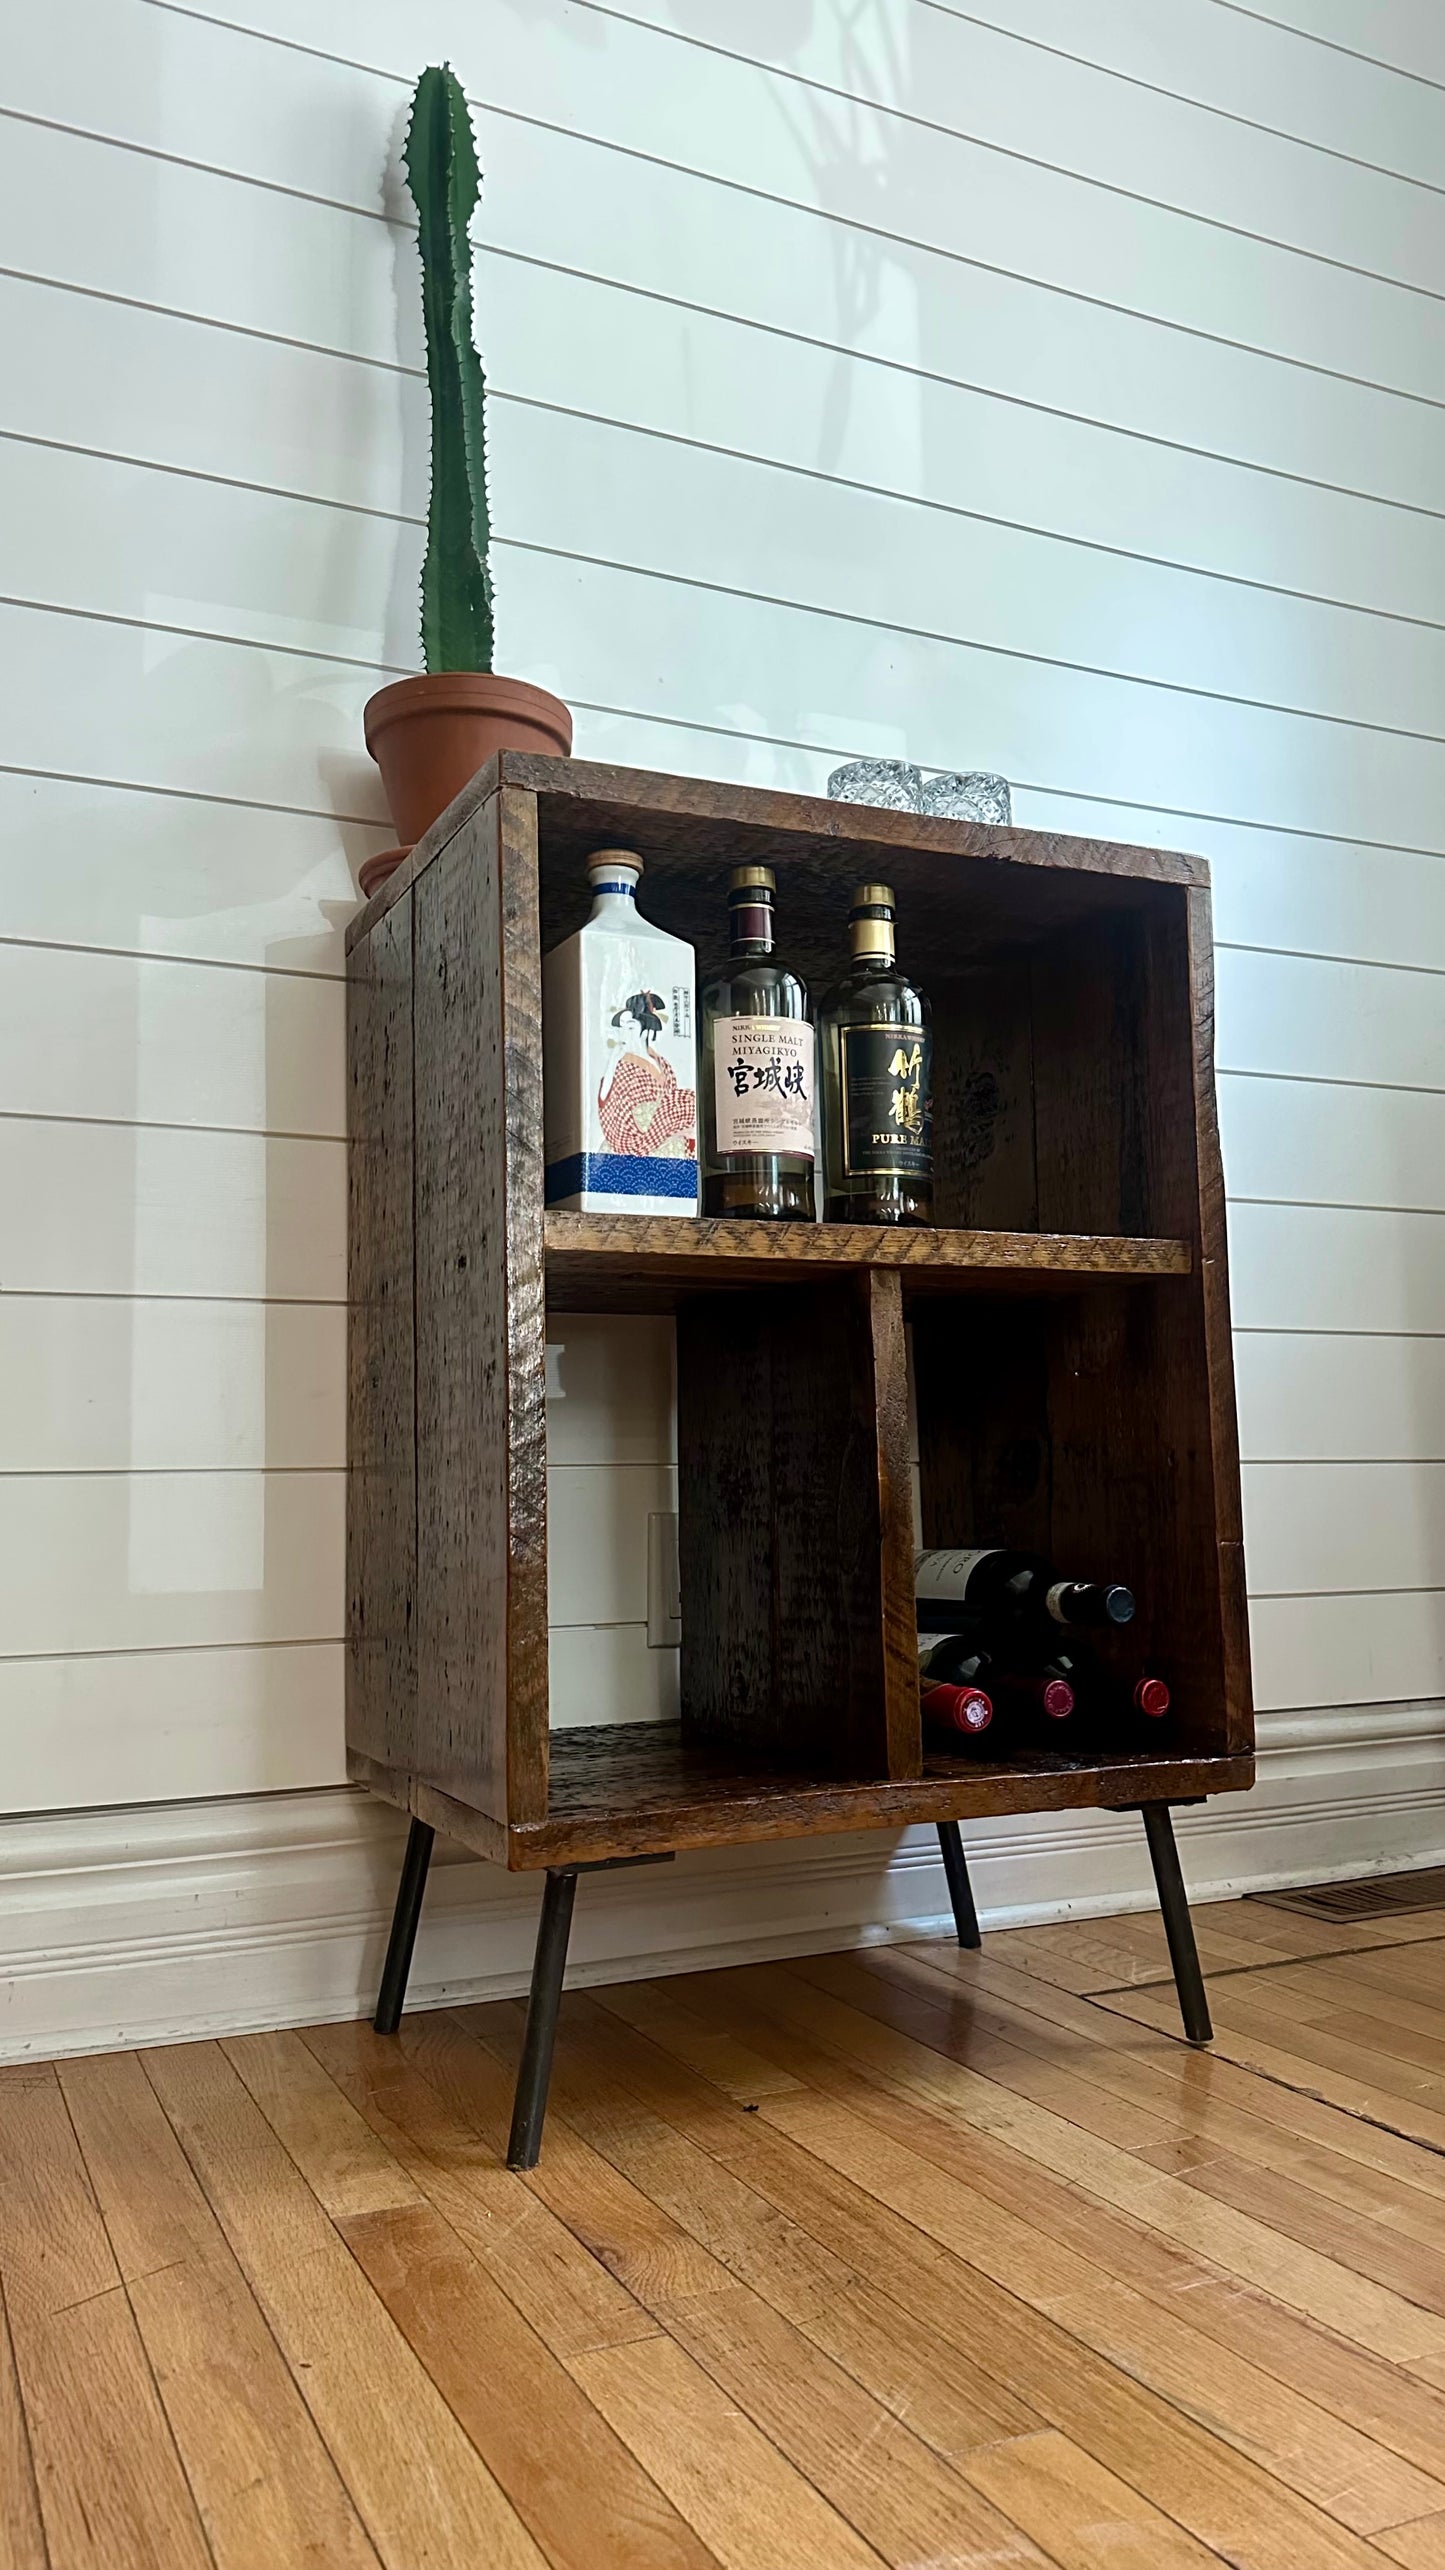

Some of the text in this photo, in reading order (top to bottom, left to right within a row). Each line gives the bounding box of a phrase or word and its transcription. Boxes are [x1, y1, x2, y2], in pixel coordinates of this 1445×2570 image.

[731, 1033, 804, 1047] SINGLE MALT
[732, 1046, 797, 1057] MIYAGIKYO
[727, 1057, 807, 1101] 宮城峡
[872, 1133, 908, 1145] PURE
